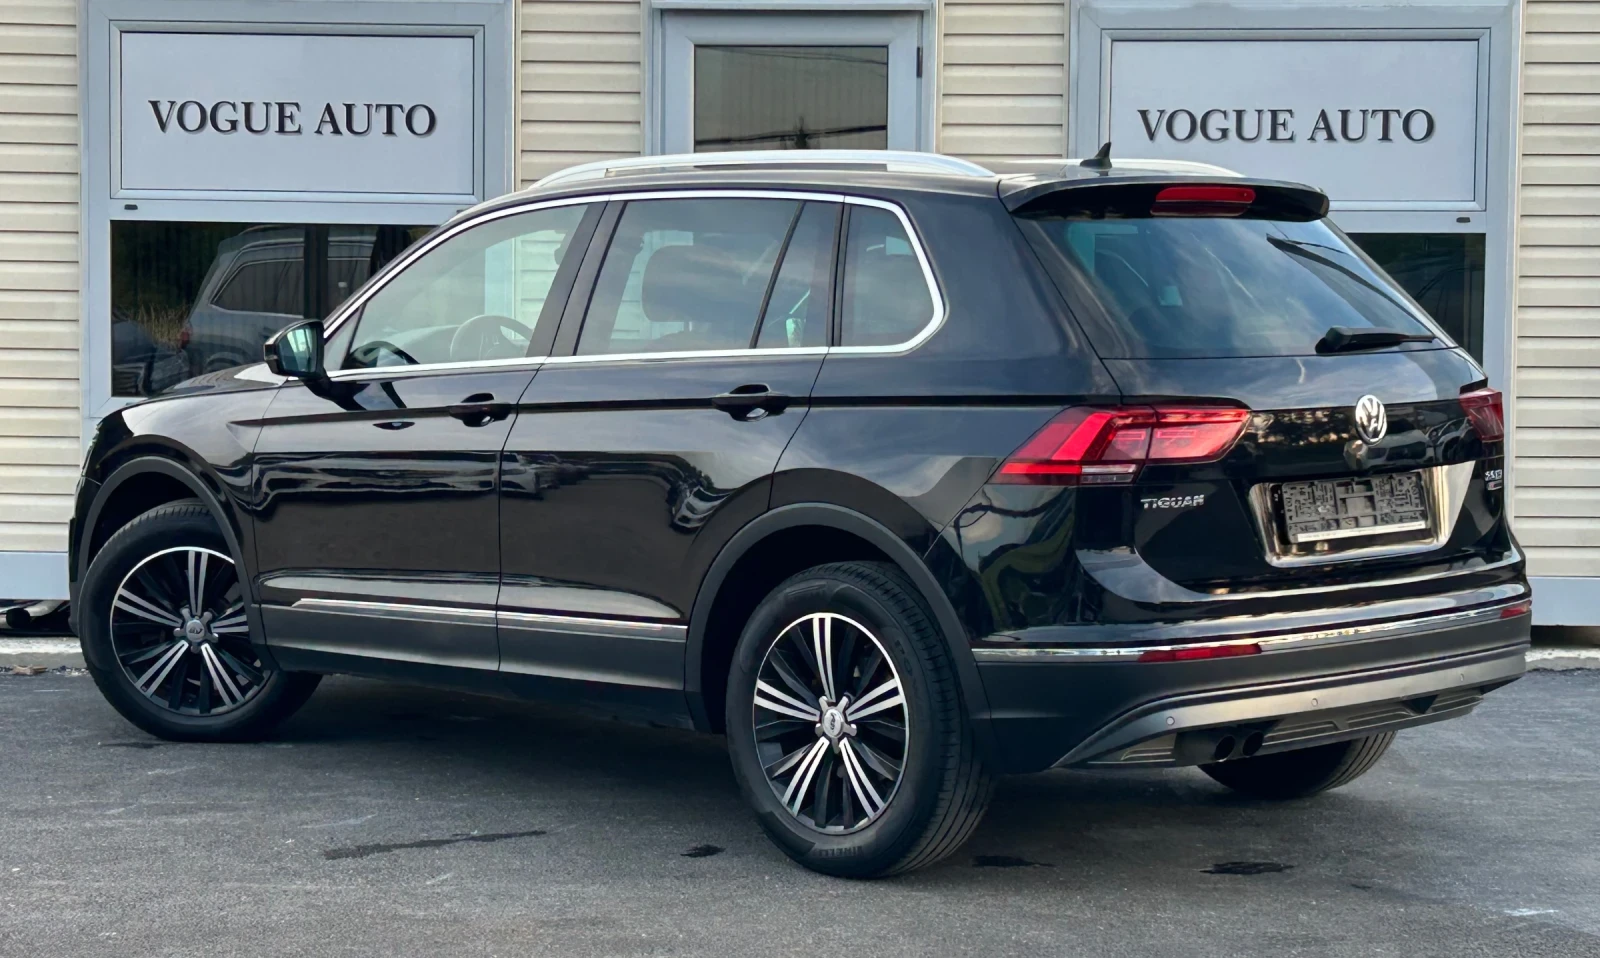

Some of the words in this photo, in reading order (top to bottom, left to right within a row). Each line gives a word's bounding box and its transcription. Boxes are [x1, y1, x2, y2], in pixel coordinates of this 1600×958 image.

[148, 100, 302, 135] VOGUE
[314, 102, 437, 137] AUTO
[1137, 109, 1296, 143] VOGUE
[1307, 108, 1435, 143] AUTO
[1140, 494, 1205, 509] TIGUAN
